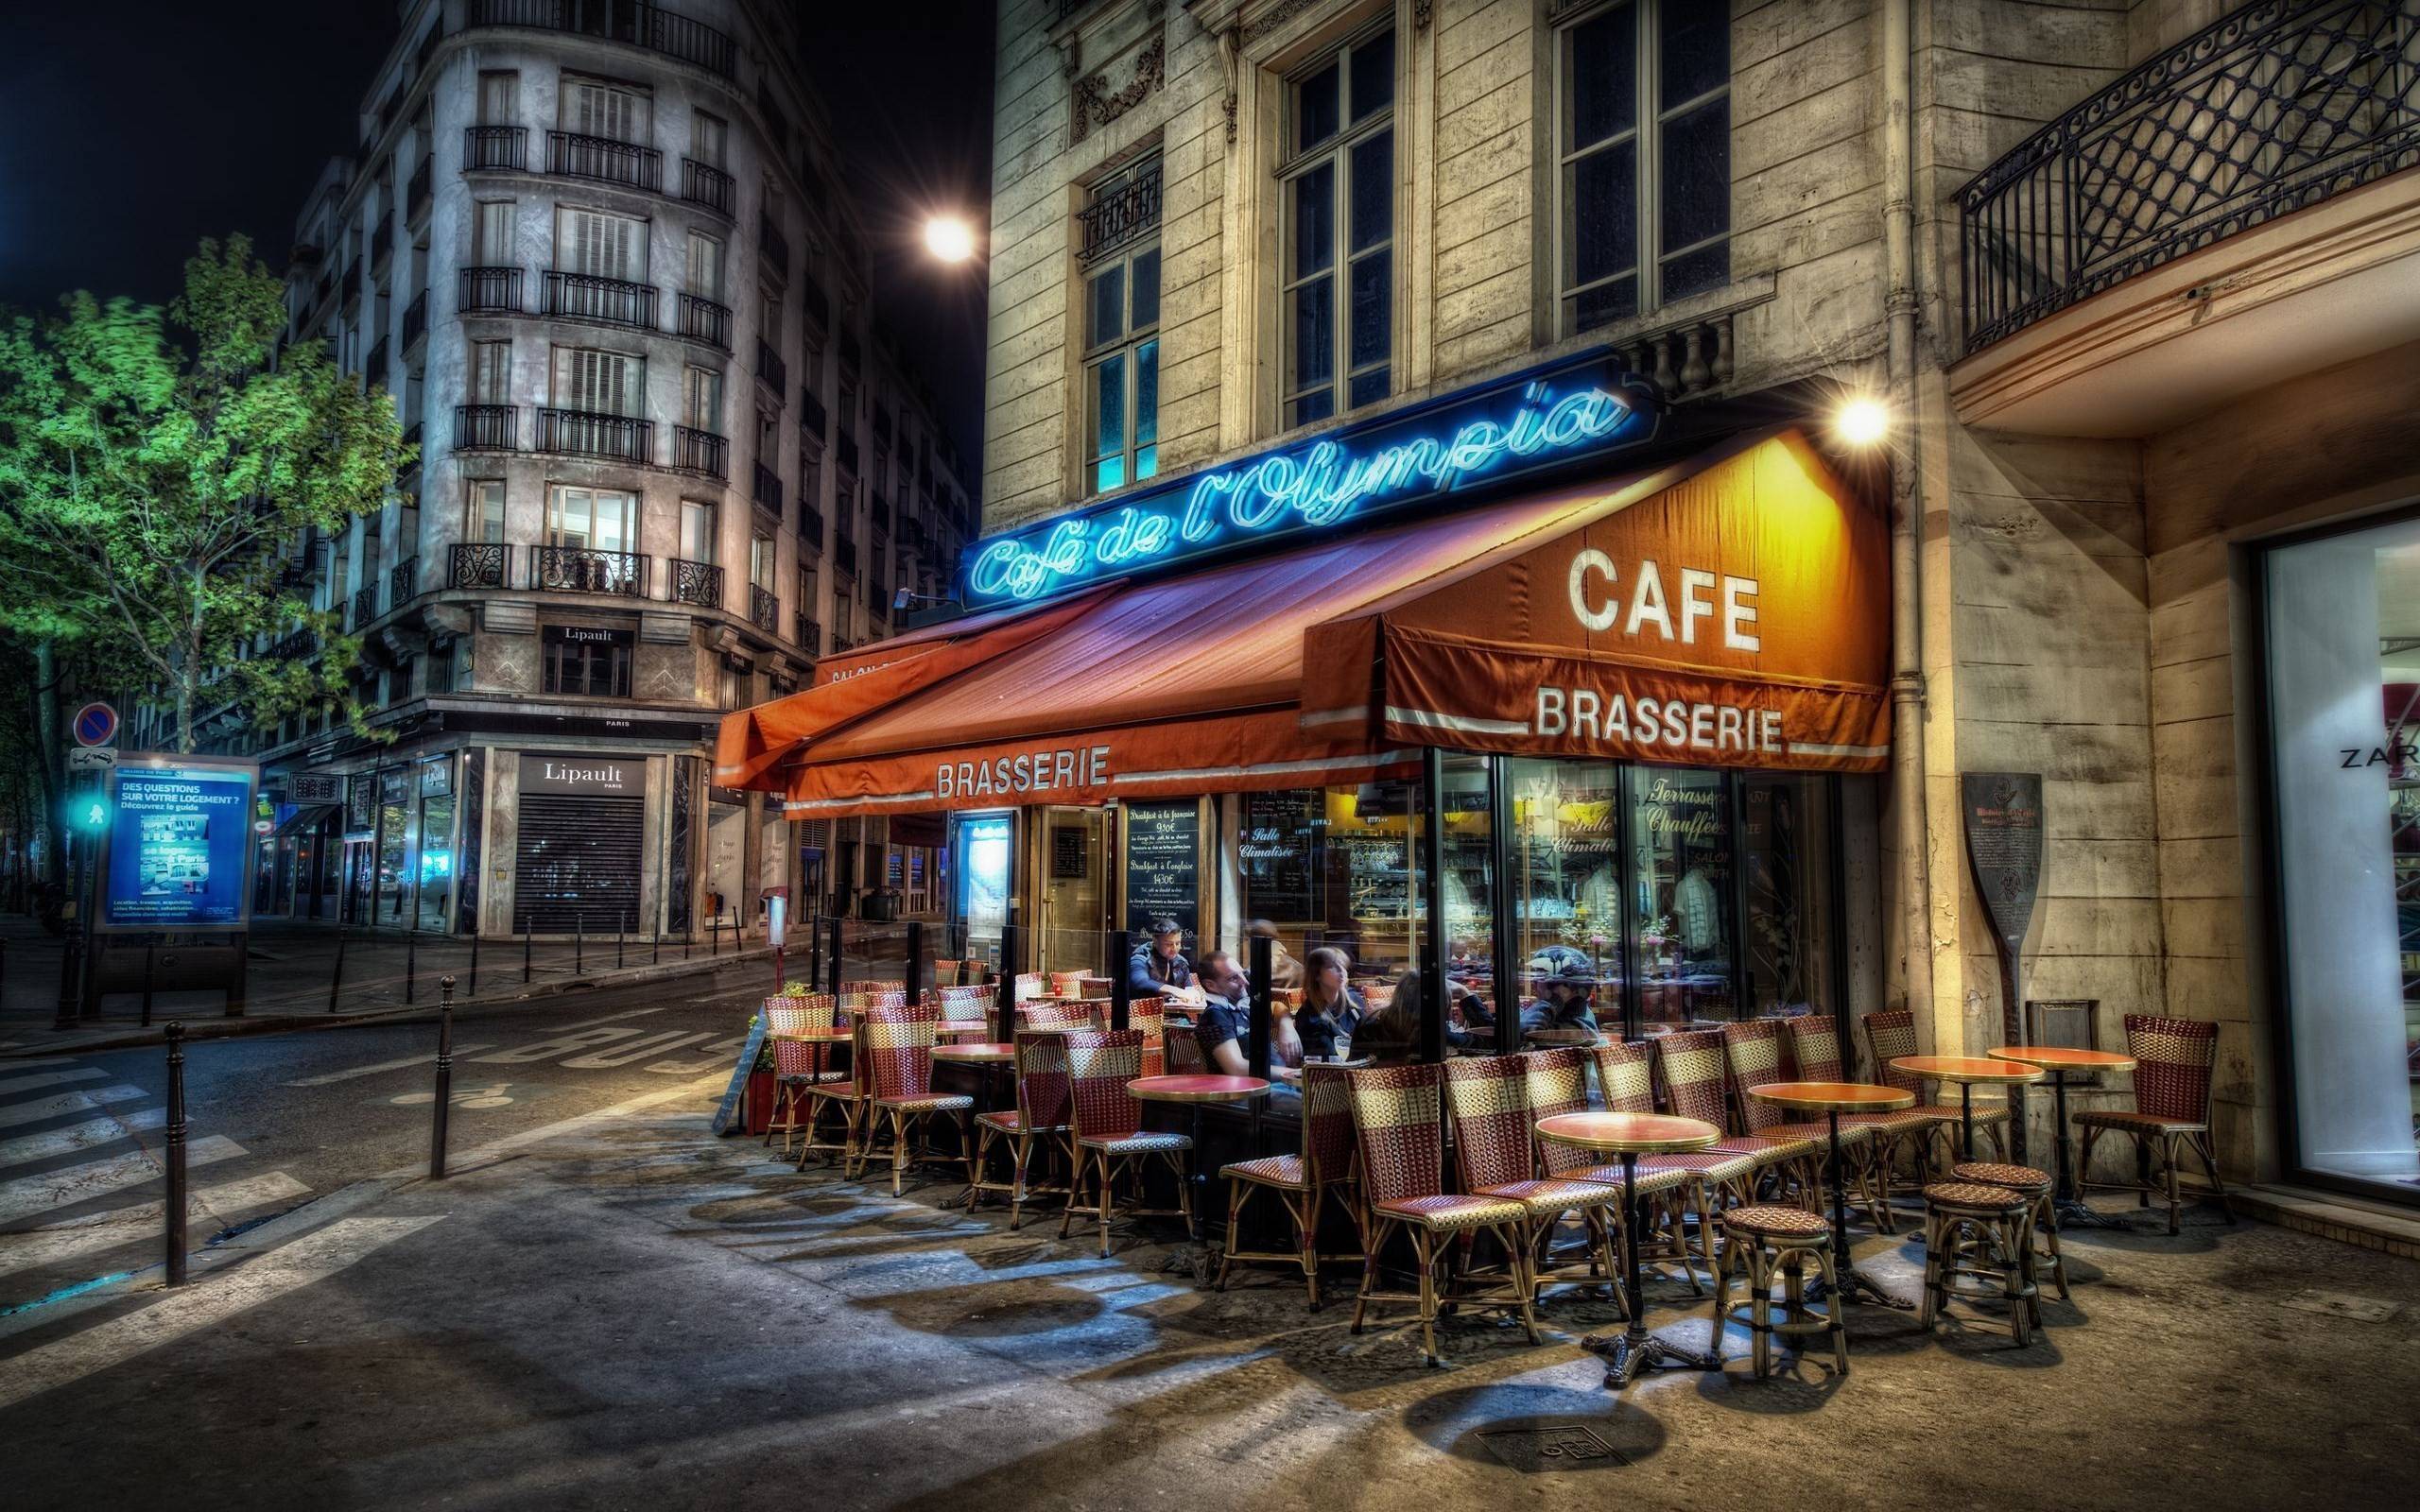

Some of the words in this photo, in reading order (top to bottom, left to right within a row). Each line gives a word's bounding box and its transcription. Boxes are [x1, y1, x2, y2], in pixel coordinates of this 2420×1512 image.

[971, 519, 1090, 599] Café
[1097, 507, 1171, 563] de
[1182, 381, 1630, 542] l'Olympia
[1567, 547, 1761, 653] CAFE
[565, 627, 613, 642] Lipault
[1537, 686, 1783, 754] BRASSERIE
[544, 763, 623, 783] Lipault
[937, 745, 1111, 799] BRASSERIE
[122, 782, 142, 791] DES
[144, 783, 200, 794] QUESTIONS
[122, 792, 143, 801] SUR
[144, 793, 179, 802] VOTRE
[180, 795, 233, 804] LOGEMENT
[1649, 778, 1716, 805] Terrasse
[1252, 828, 1280, 841] Salle
[1646, 807, 1720, 842] Chauffée
[1239, 845, 1294, 858] Climatisée
